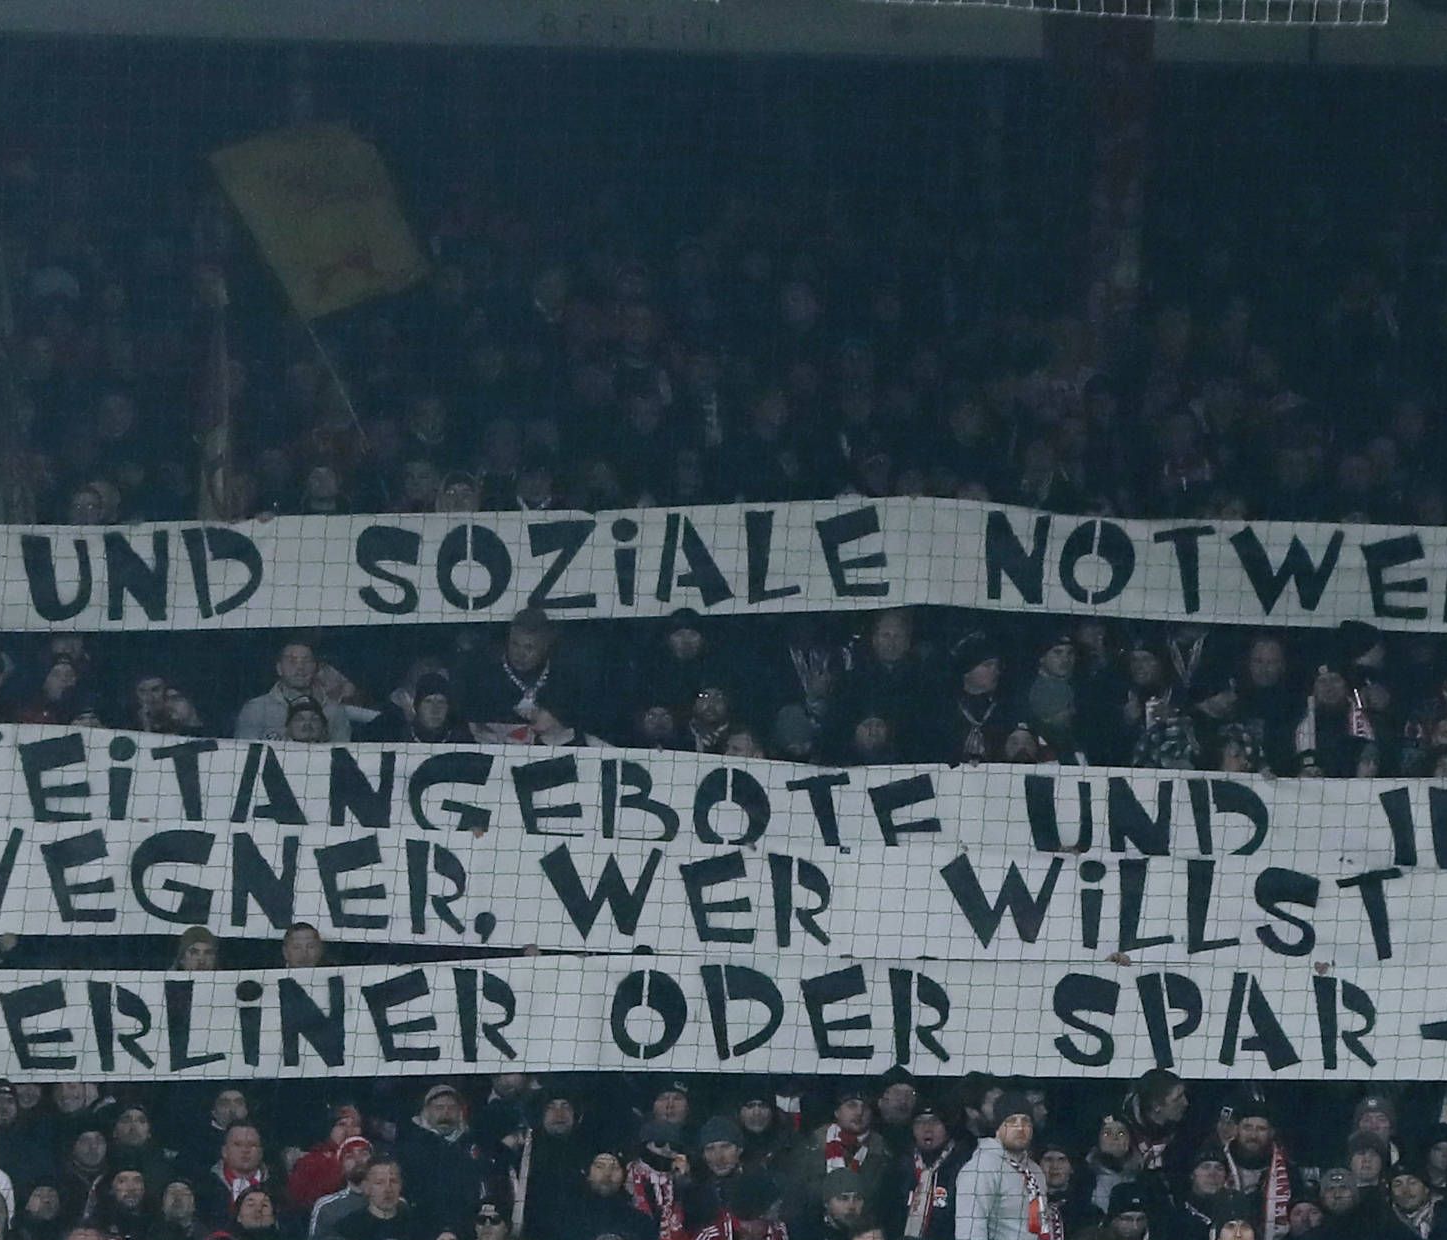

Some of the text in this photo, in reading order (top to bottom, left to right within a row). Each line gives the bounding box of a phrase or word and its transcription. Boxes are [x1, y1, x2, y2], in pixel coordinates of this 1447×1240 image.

[21, 525, 264, 623] UND
[1023, 774, 1271, 858] UND
[538, 842, 833, 947] WER
[609, 965, 951, 1064] ODER
